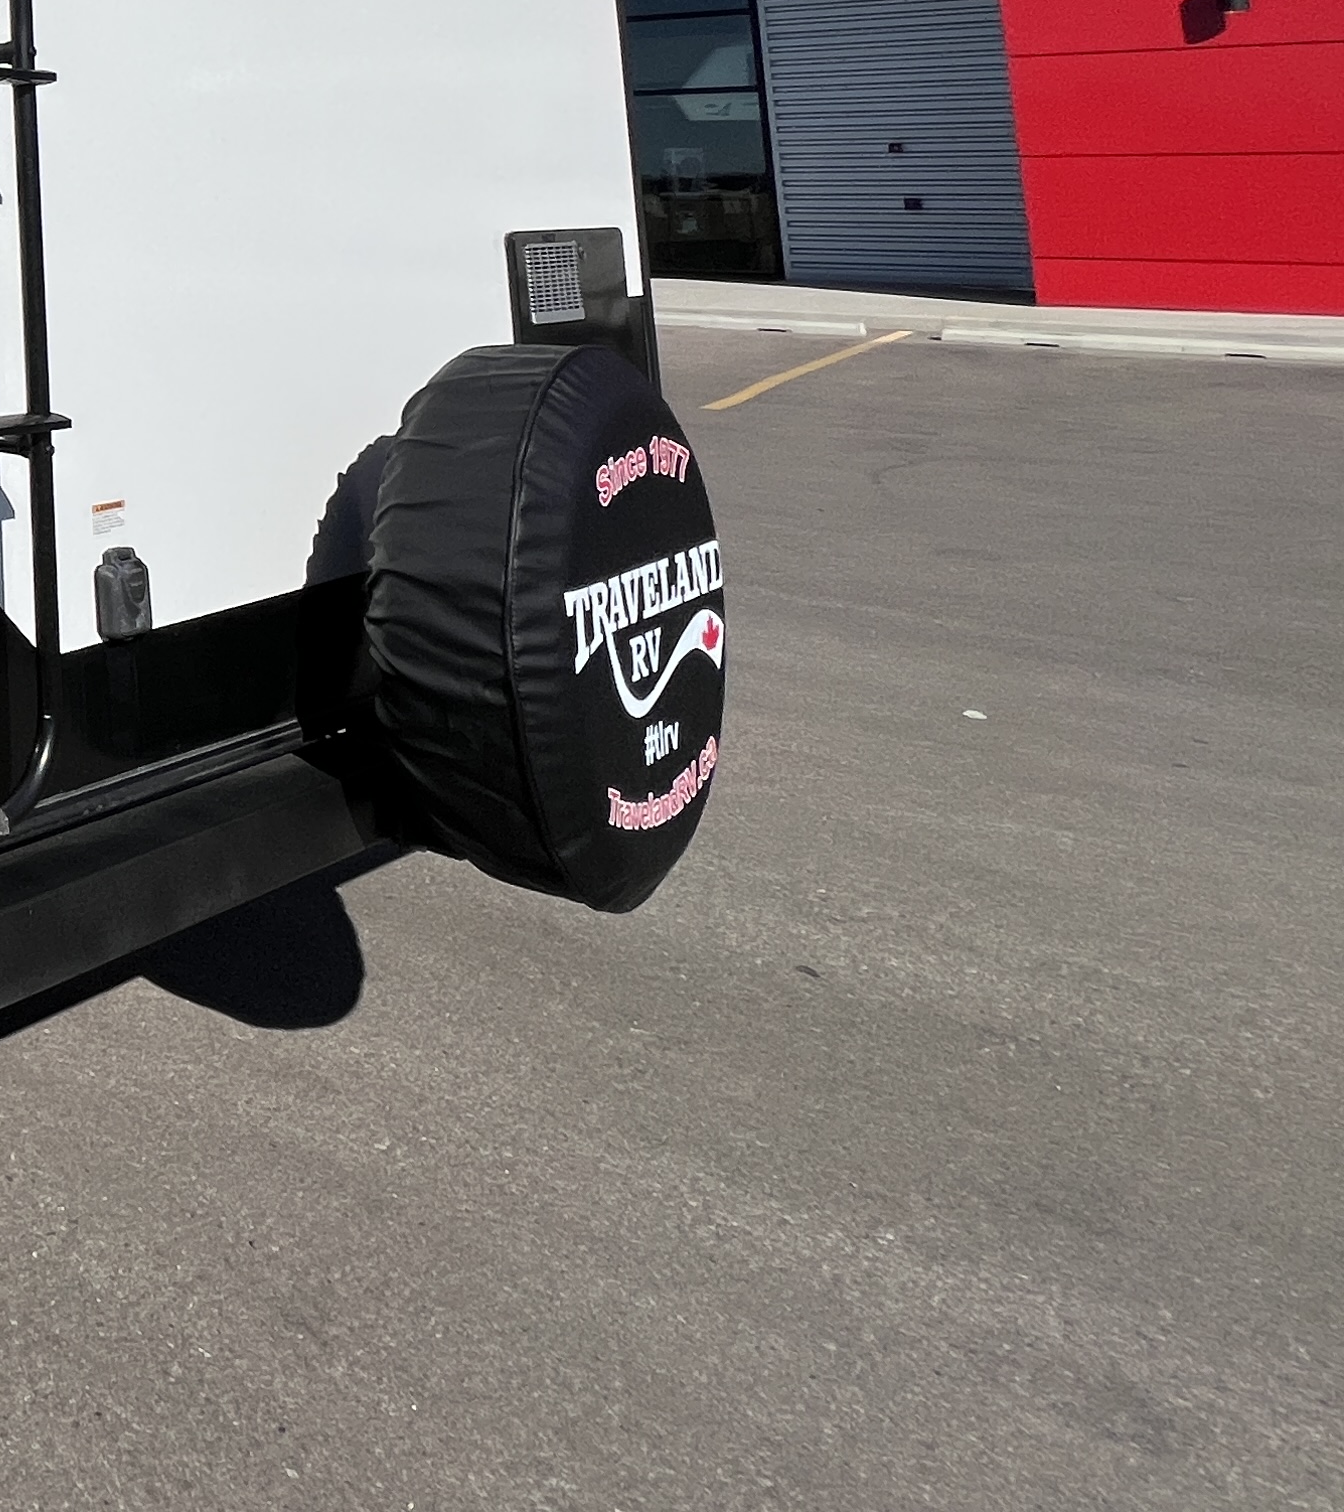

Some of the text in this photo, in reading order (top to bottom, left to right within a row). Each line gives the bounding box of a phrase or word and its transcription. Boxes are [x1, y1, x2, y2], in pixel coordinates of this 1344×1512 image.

[596, 435, 690, 507] Since 1977
[564, 540, 724, 675] TRAVELAND
[629, 627, 661, 682] RV
[644, 720, 679, 766] #tlrv
